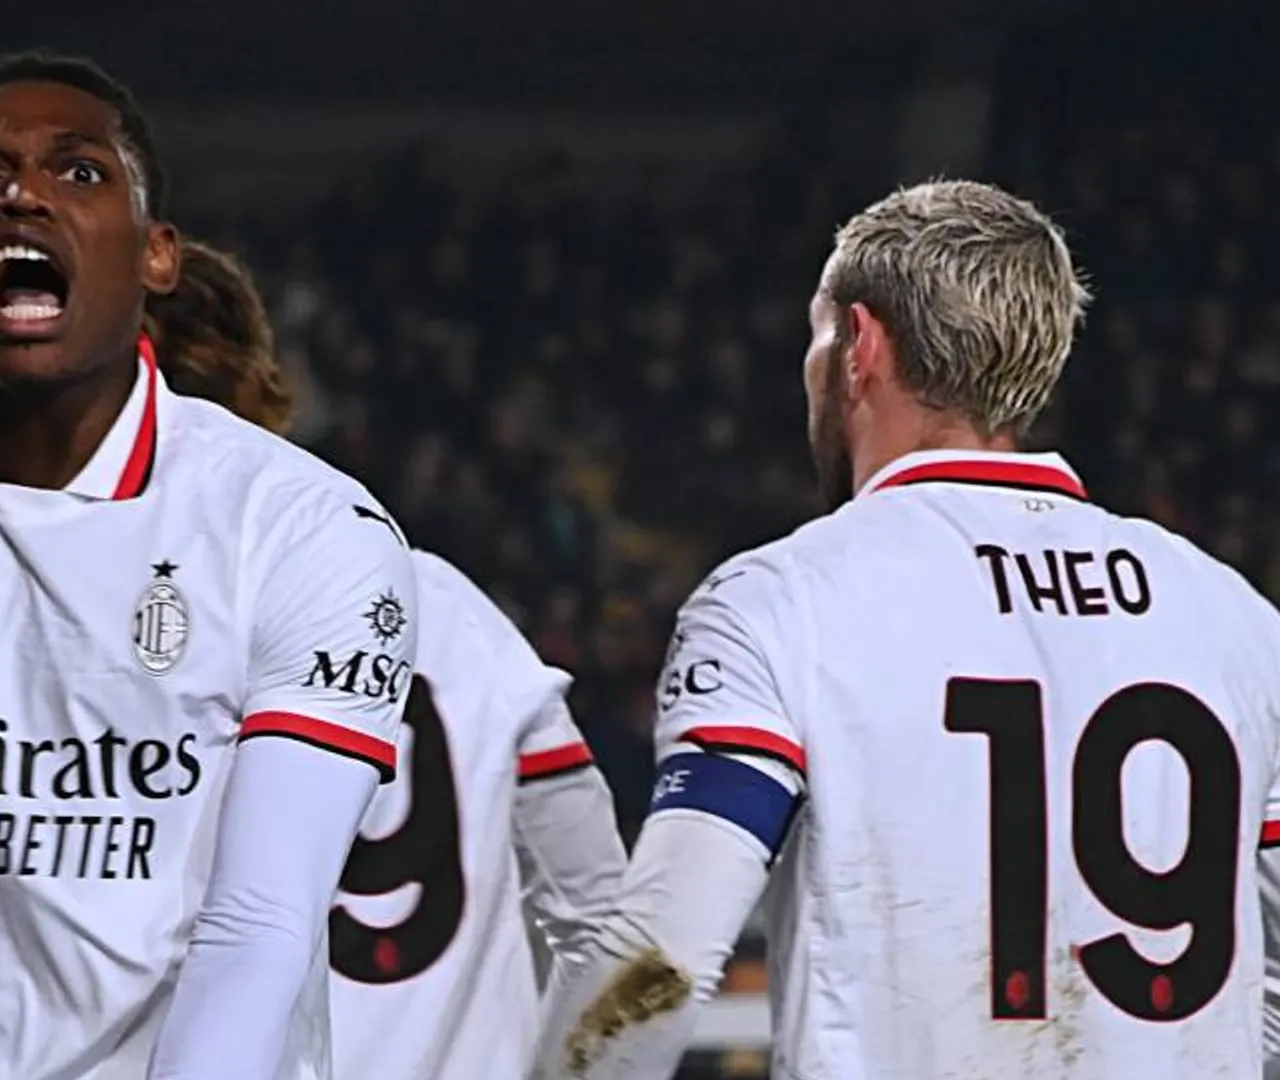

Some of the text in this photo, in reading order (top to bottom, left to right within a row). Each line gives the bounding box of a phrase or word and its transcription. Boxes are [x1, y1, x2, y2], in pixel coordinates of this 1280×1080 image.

[974, 544, 1152, 617] THEO
[663, 659, 724, 711] SC
[328, 672, 465, 985] 9
[944, 676, 1242, 1023] 19
